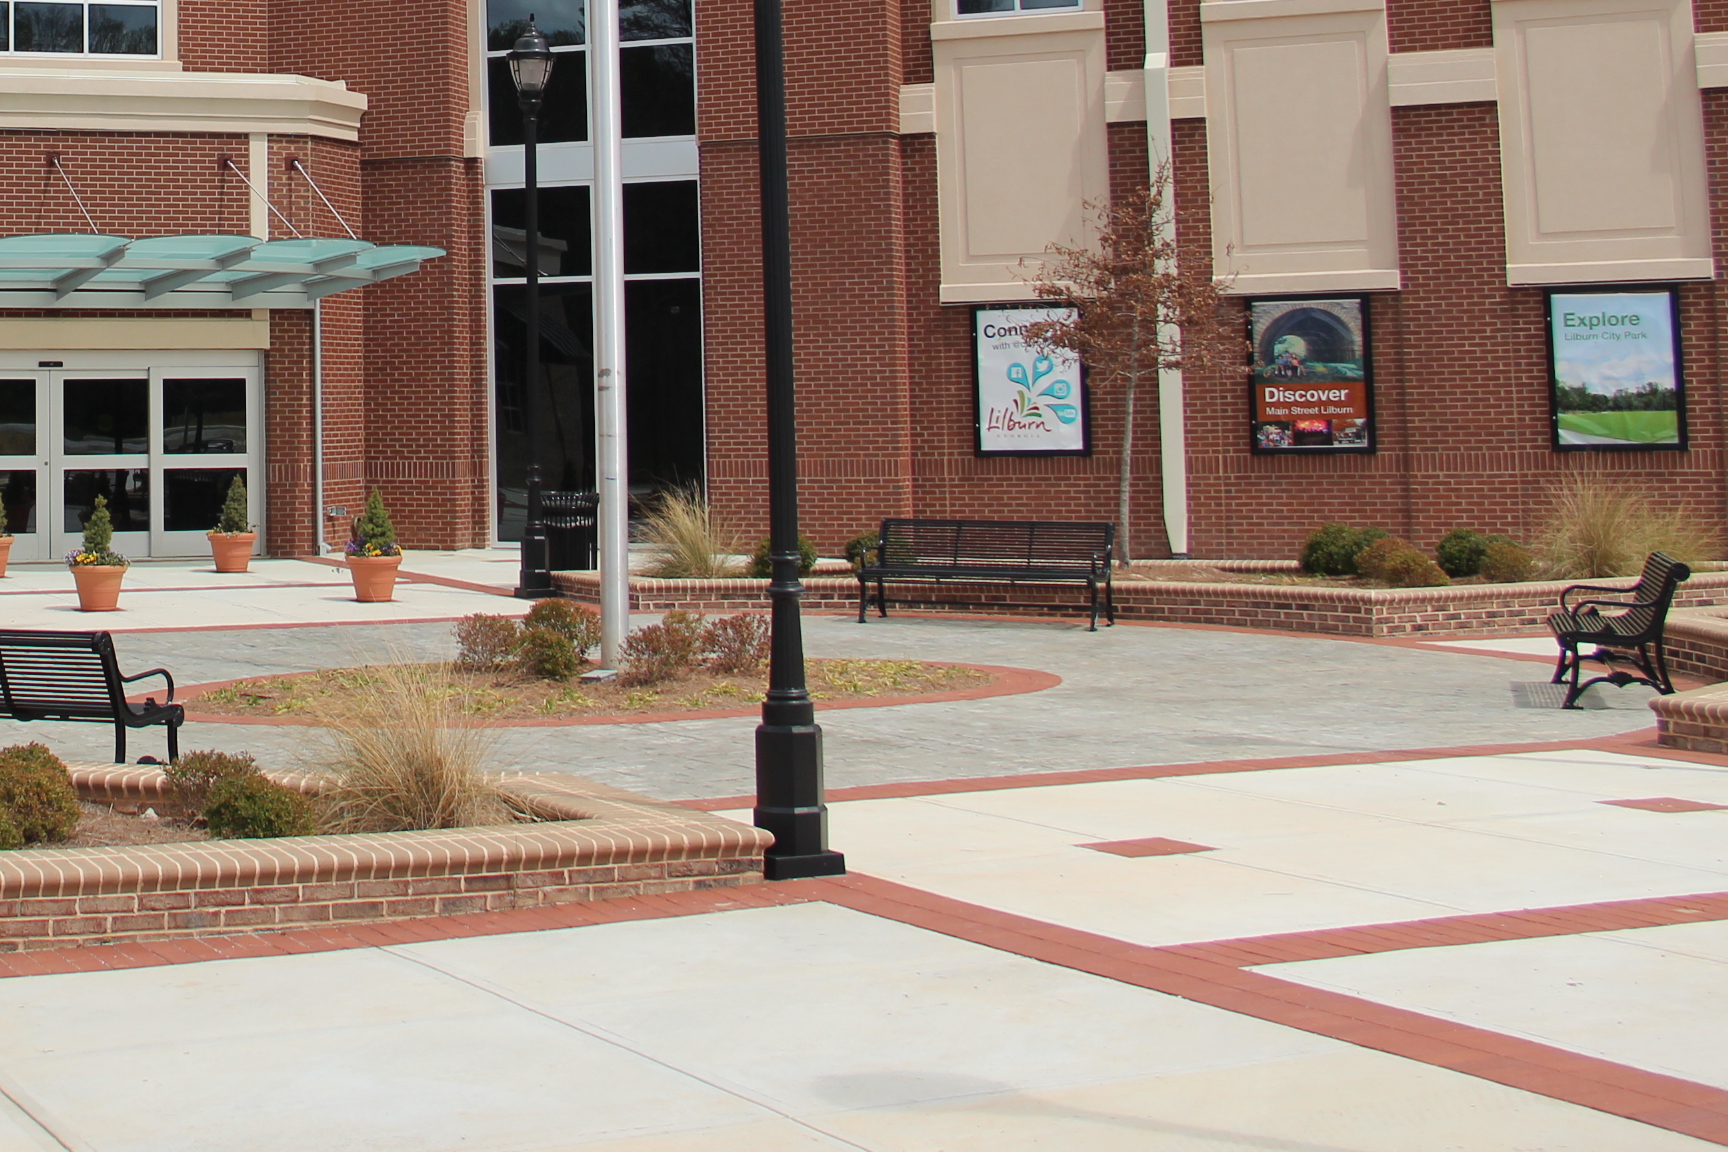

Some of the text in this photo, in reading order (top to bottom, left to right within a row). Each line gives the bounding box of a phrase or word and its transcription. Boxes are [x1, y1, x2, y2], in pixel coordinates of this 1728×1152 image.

[1563, 311, 1640, 330] Explore
[1564, 331, 1648, 341] Lilburn City Park
[992, 342, 1010, 350] with
[1264, 386, 1348, 402] Discover
[1266, 405, 1353, 415] Main Street Lilburn
[986, 407, 1052, 433] Lilburn
